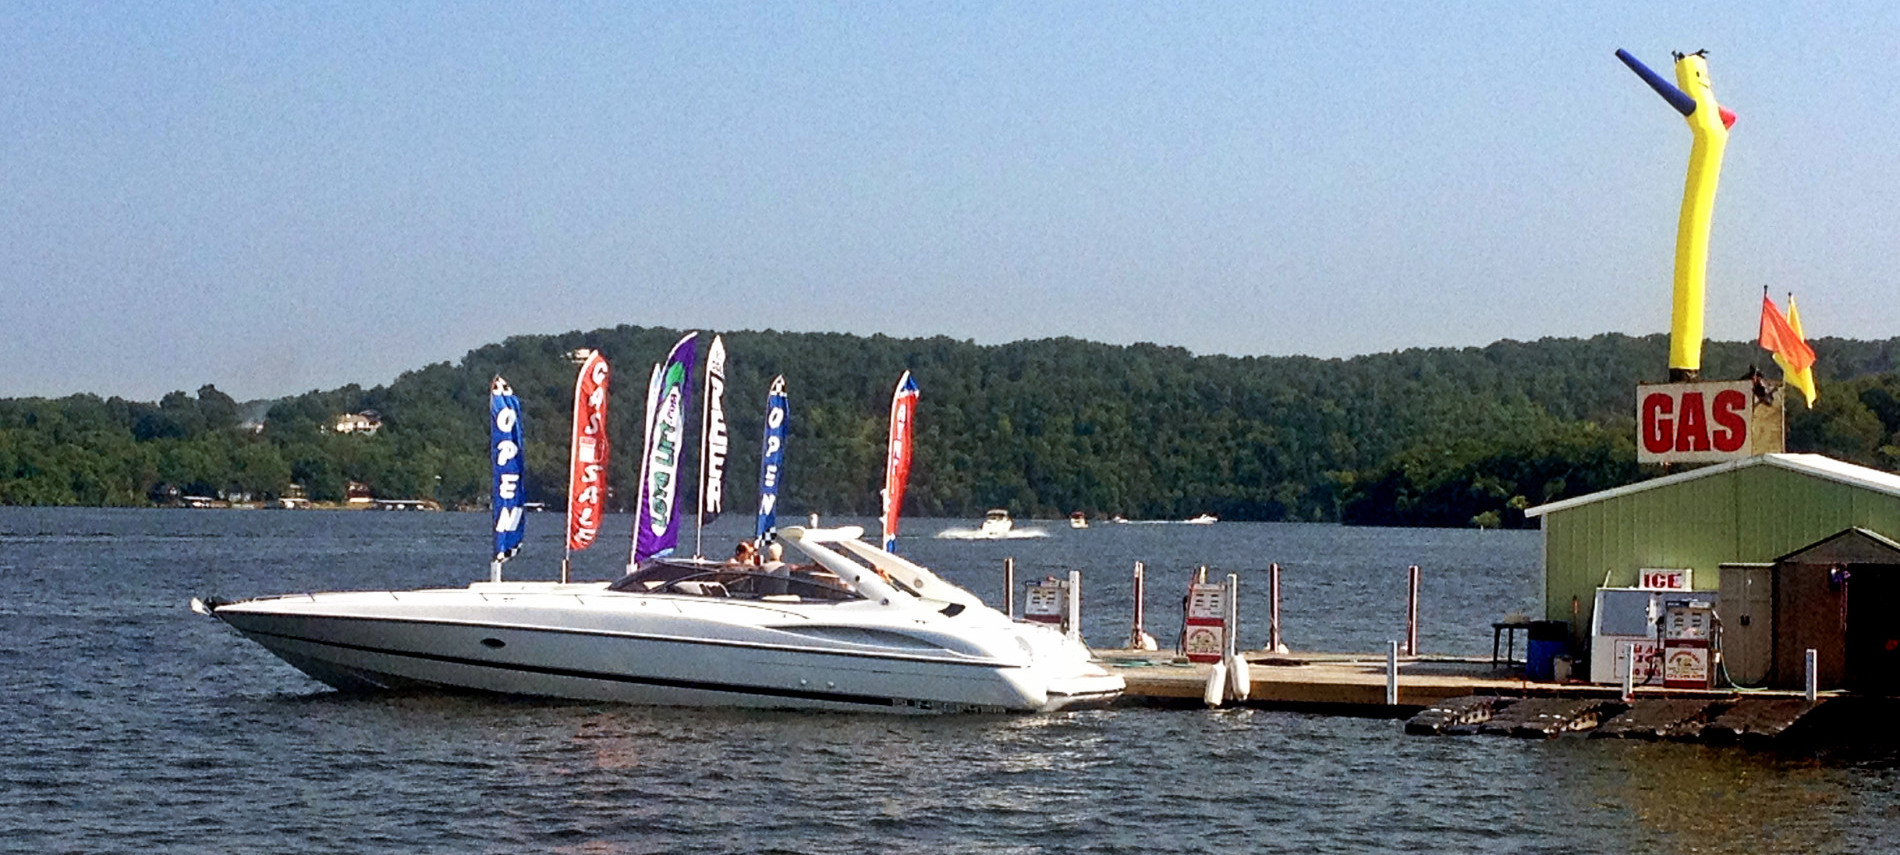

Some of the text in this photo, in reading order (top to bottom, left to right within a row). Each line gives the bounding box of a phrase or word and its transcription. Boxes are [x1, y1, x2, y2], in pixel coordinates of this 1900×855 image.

[496, 407, 523, 533] OPEN
[574, 361, 608, 545] GAS SALE
[758, 407, 784, 516] OPEN
[1642, 389, 1747, 454] GAS
[1643, 572, 1683, 589] ICE
